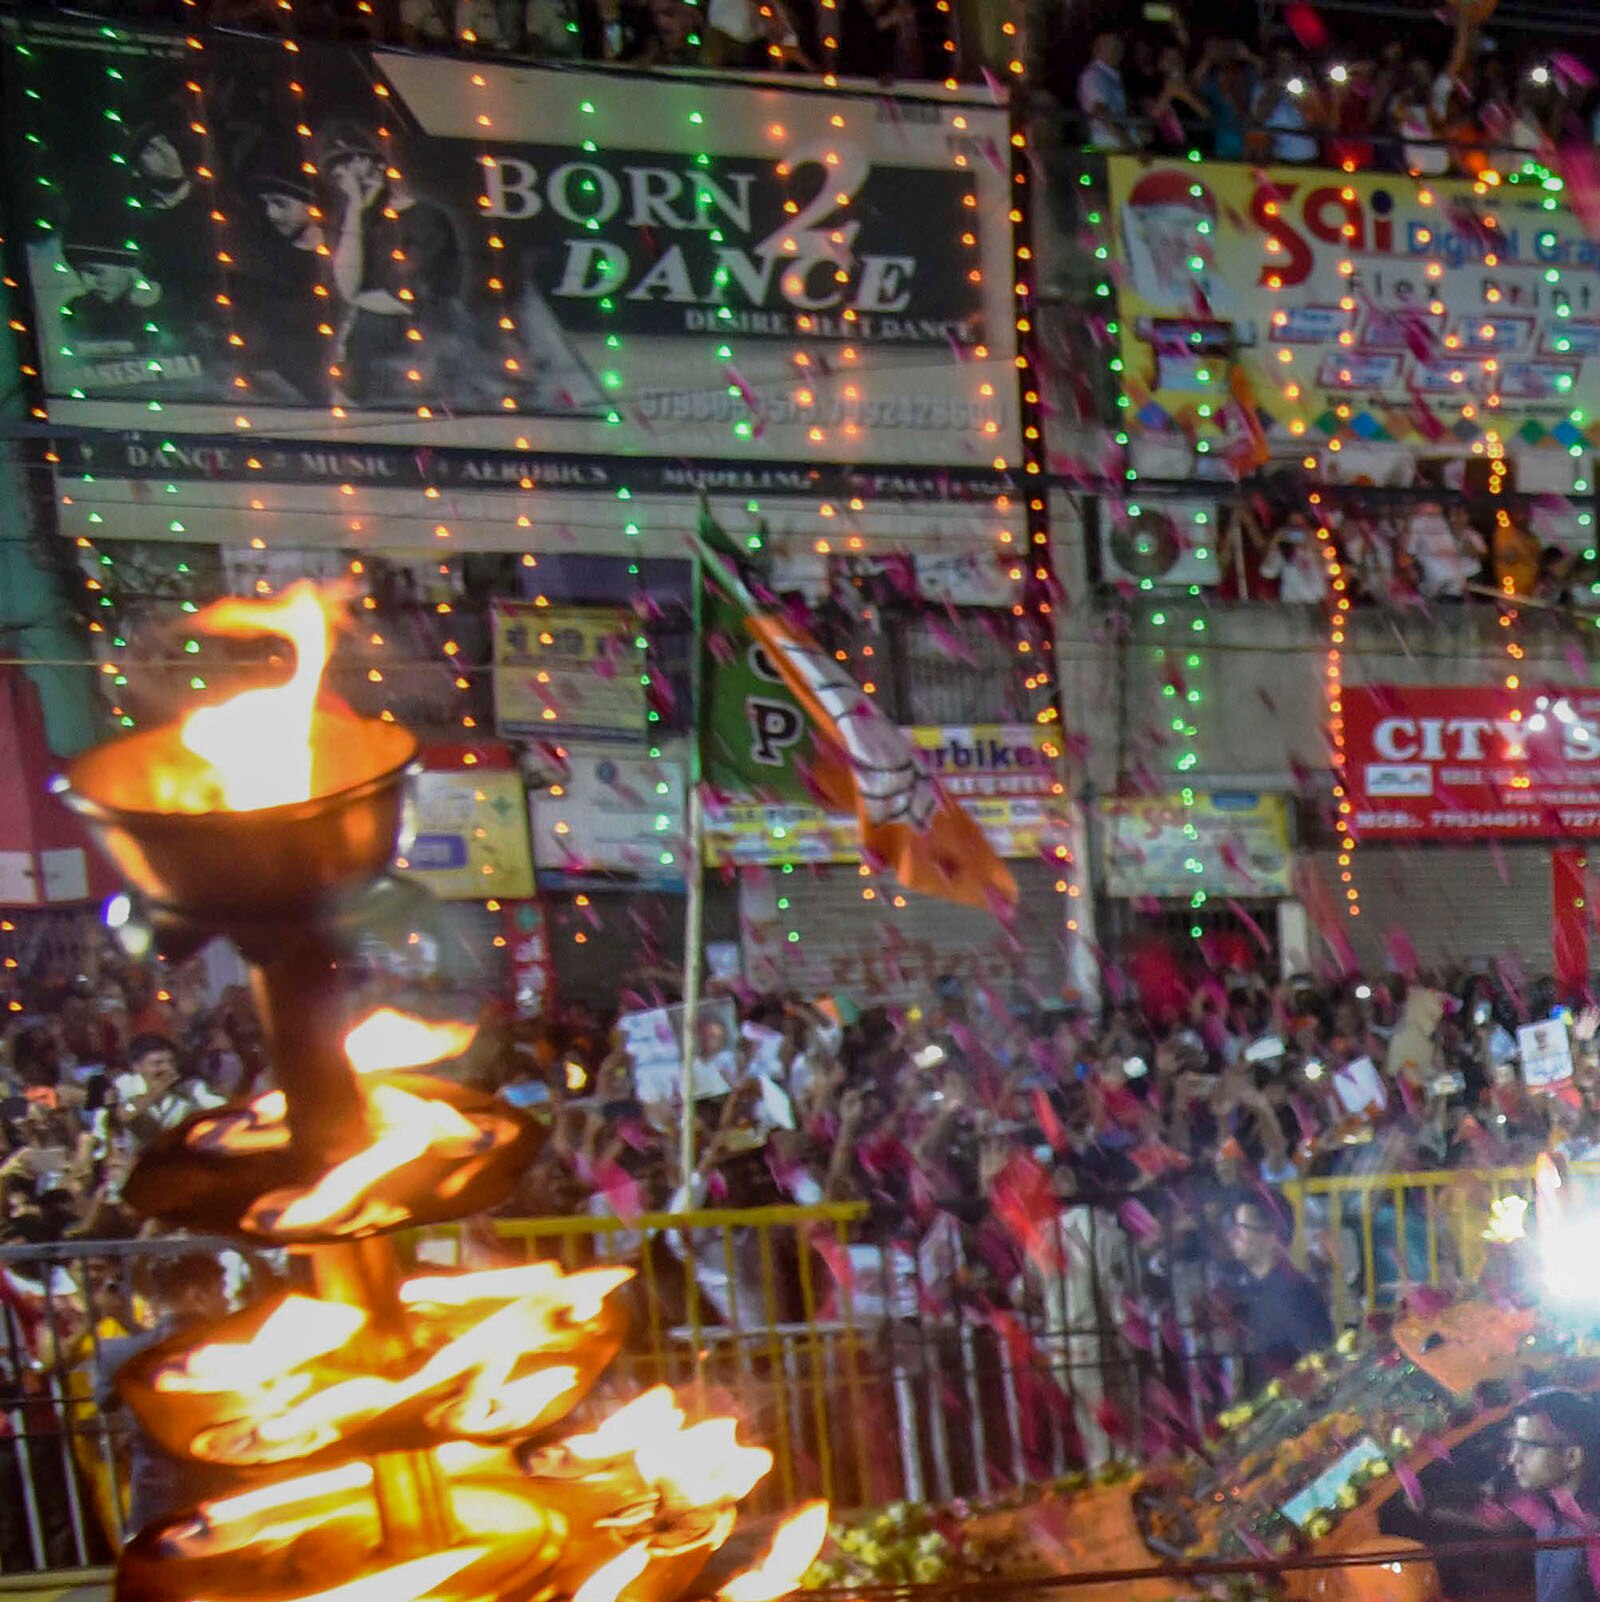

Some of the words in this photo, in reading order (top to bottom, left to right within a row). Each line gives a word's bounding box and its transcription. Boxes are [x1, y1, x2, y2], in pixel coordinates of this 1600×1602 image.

[476, 155, 756, 234] BORN
[755, 139, 869, 268] 2
[1252, 183, 1395, 288] Sai
[1405, 221, 1520, 269] Digal
[552, 239, 917, 312] DANCE
[1347, 270, 1441, 301] Flex
[127, 445, 235, 473] DANCE
[301, 452, 397, 478] MUSIC
[1373, 718, 1532, 762] CITY
